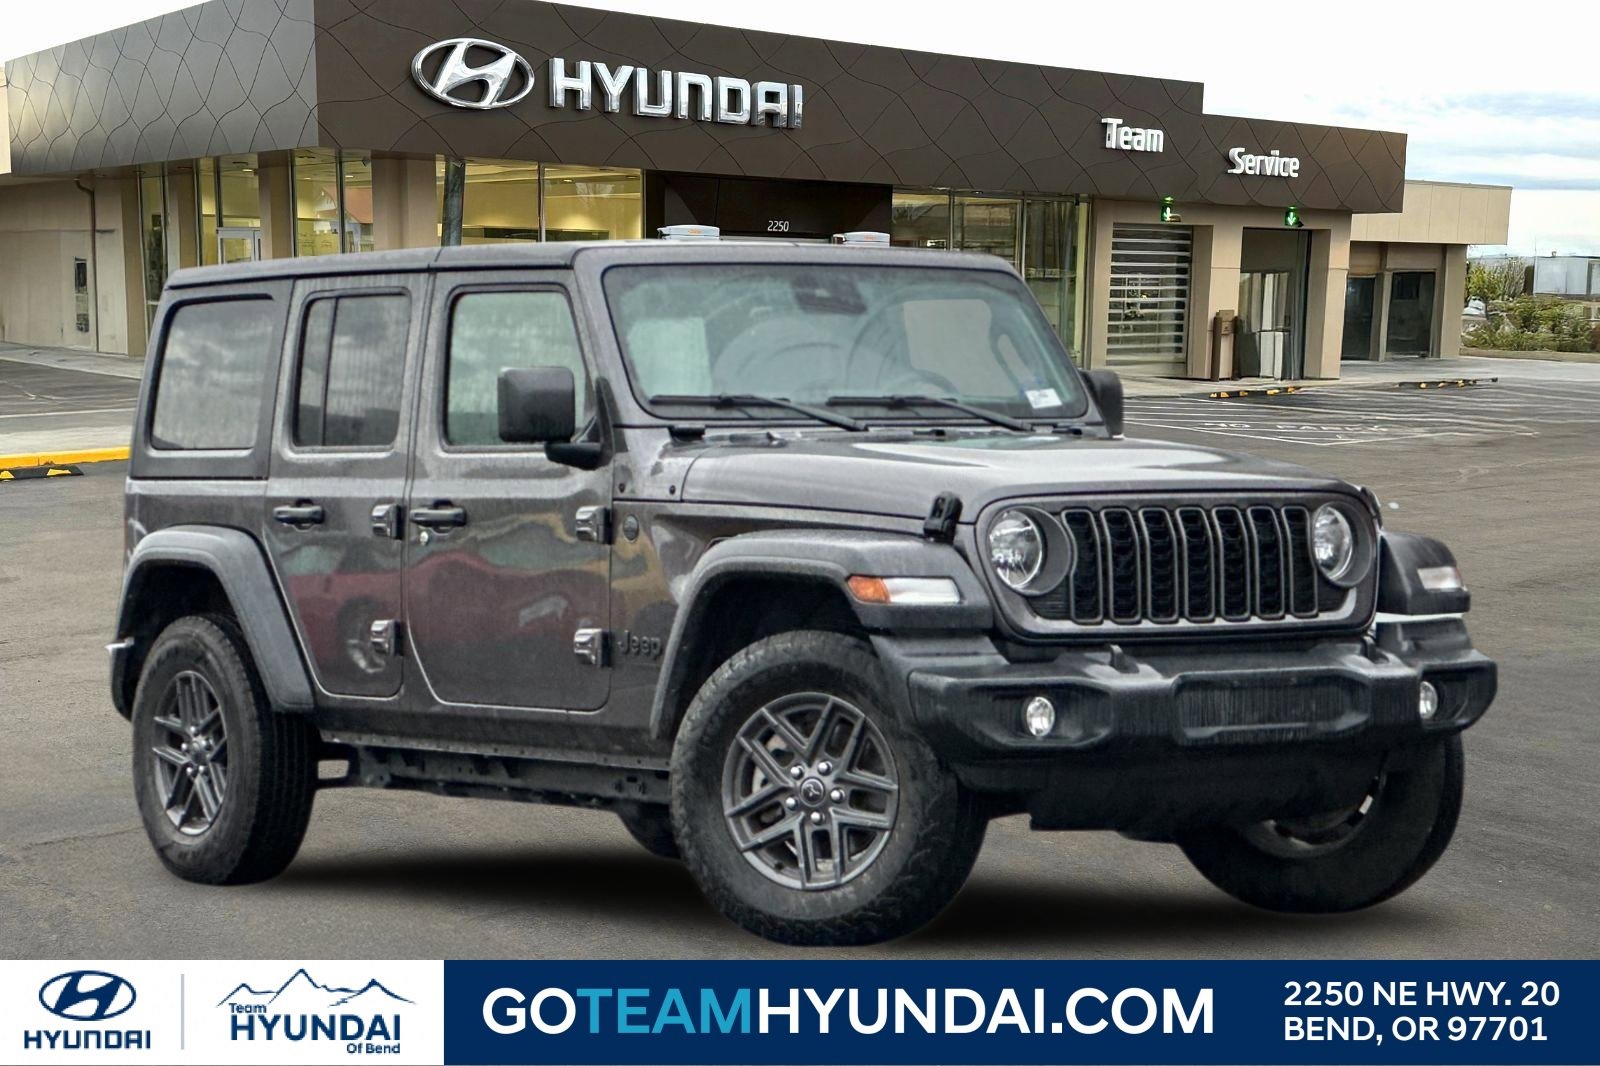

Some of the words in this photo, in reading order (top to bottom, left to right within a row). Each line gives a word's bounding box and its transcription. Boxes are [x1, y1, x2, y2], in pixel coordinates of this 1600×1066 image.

[548, 57, 803, 129] HYUNDAI
[1101, 117, 1164, 153] Team
[1227, 147, 1300, 178] Service
[767, 220, 790, 232] 2250
[617, 629, 662, 658] Jeep
